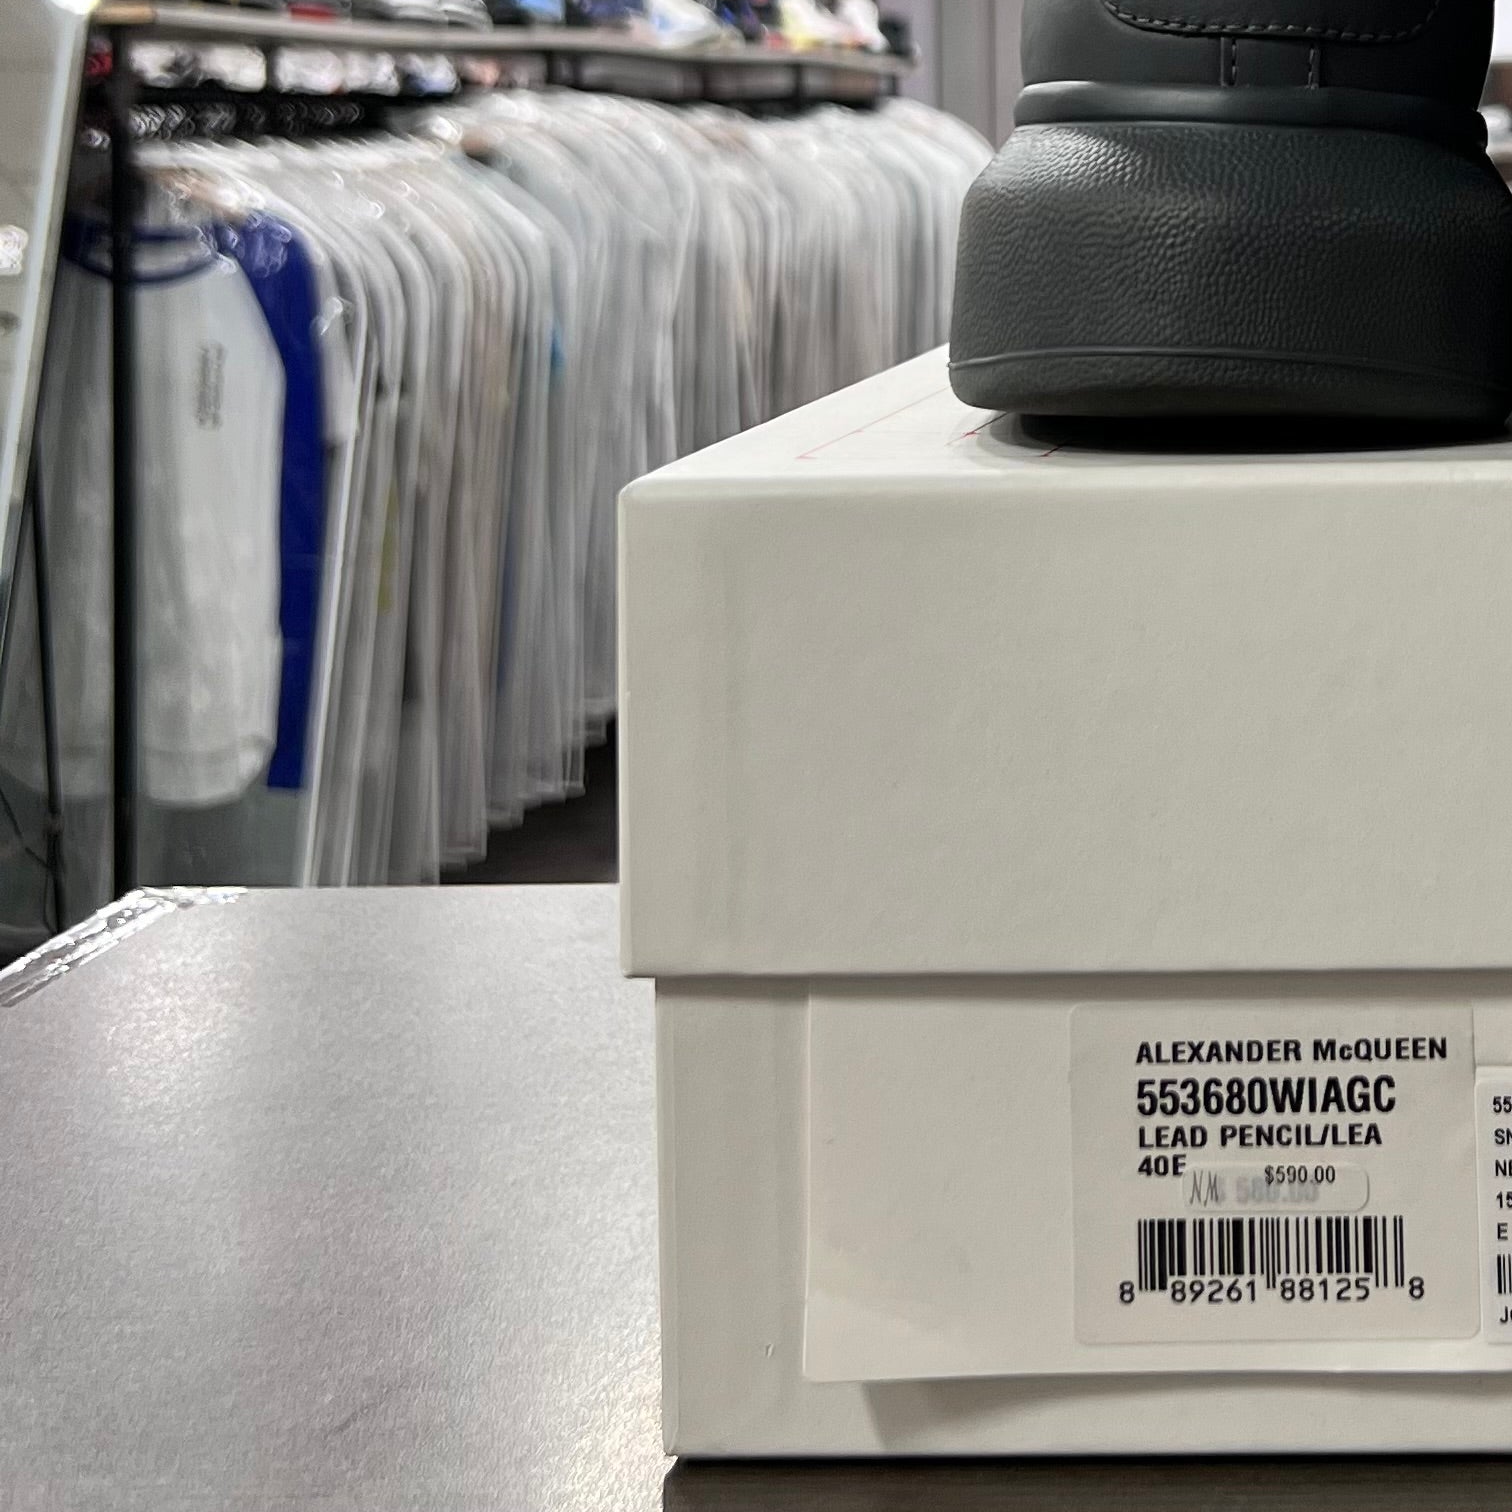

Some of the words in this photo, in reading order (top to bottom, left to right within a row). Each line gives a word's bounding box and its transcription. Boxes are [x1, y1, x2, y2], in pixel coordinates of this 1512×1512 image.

[1136, 1041, 1302, 1064] ALEXANDER
[1312, 1037, 1448, 1062] McQUEEN
[1136, 1075, 1397, 1116] 553680WIAGC
[1138, 1125, 1208, 1149] LEAD
[1220, 1123, 1383, 1147] PENCIL/LEA
[1137, 1154, 1187, 1178] 40E
[1264, 1164, 1336, 1186] $590.00
[1497, 1223, 1508, 1240] E
[1119, 1280, 1136, 1304] 8
[1170, 1279, 1257, 1303] 89261
[1280, 1278, 1371, 1302] 88125
[1408, 1276, 1425, 1300] 8
